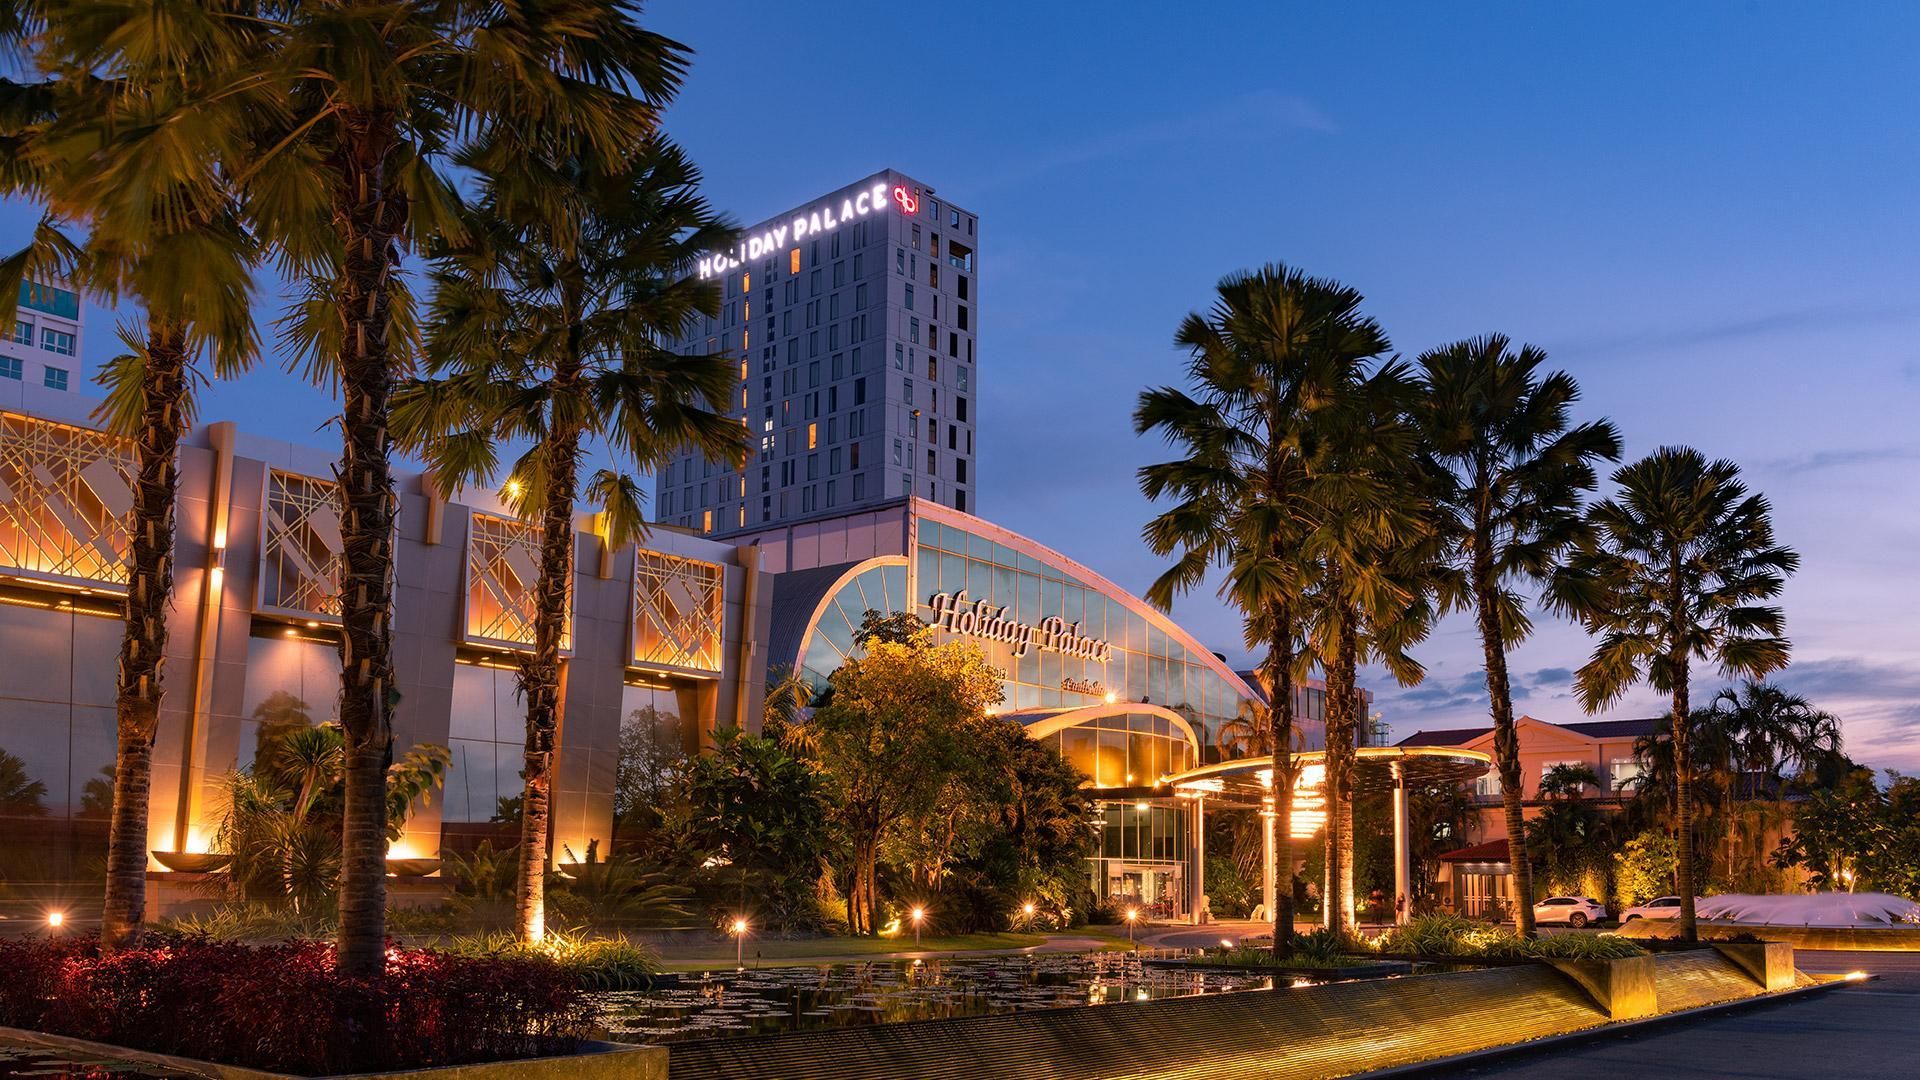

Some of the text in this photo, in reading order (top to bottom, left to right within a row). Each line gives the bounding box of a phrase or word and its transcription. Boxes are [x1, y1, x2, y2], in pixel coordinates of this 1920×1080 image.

[699, 183, 888, 280] HOLIDAY PALACE
[929, 589, 1113, 664] Holiday Palace
